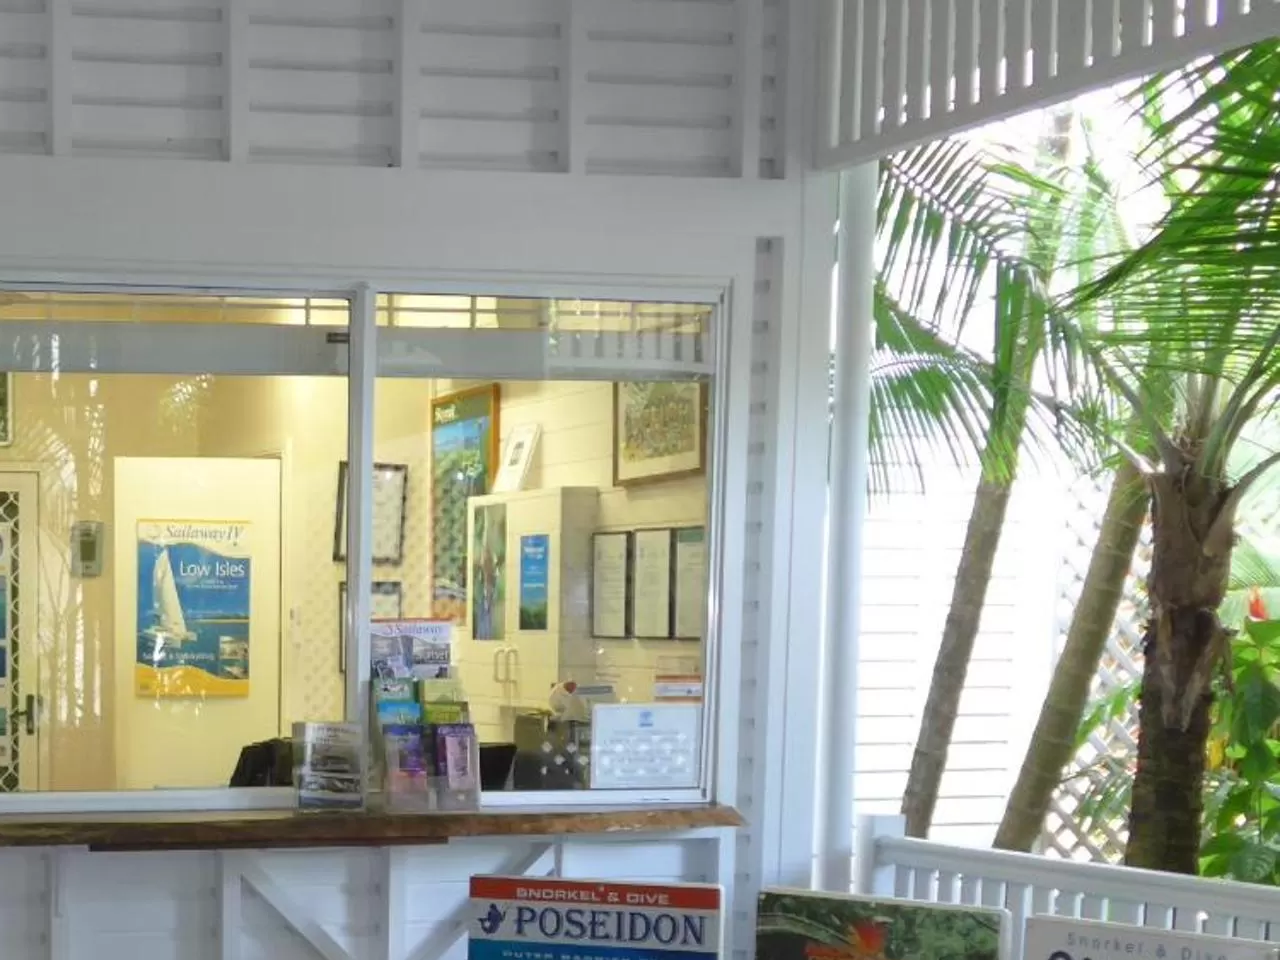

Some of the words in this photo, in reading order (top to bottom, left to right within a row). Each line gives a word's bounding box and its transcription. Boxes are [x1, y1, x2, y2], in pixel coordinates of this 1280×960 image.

[180, 560, 210, 577] Low
[216, 560, 245, 578] Isles
[516, 886, 600, 901] SNORKEL
[606, 892, 620, 903] &
[626, 892, 671, 906] DIVE
[516, 905, 707, 946] POSEIDON
[1067, 932, 1144, 954] Snorkel
